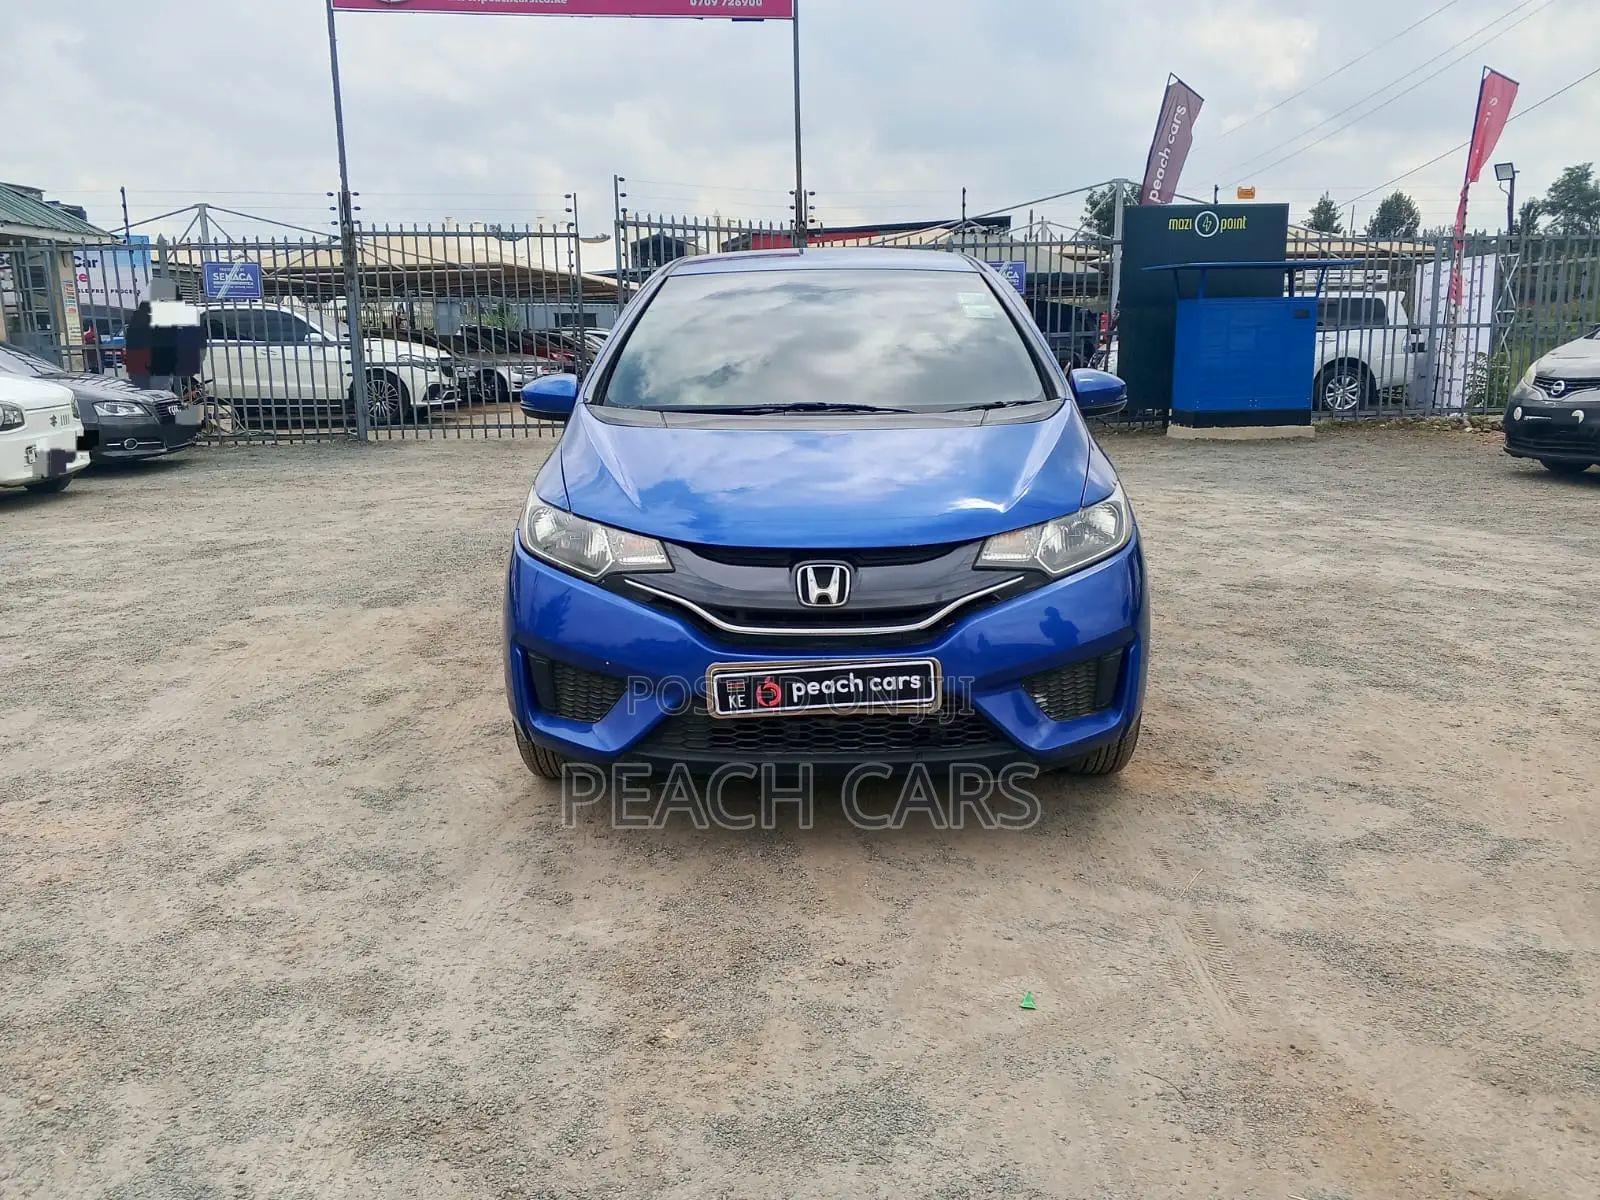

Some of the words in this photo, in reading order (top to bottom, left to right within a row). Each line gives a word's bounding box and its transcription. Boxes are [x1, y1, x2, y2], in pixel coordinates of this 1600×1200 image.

[1149, 147, 1171, 203] peach
[1168, 105, 1187, 145] cars
[1220, 215, 1247, 233] point
[792, 672, 864, 703] peach
[869, 673, 921, 693] cars
[729, 694, 747, 709] KE
